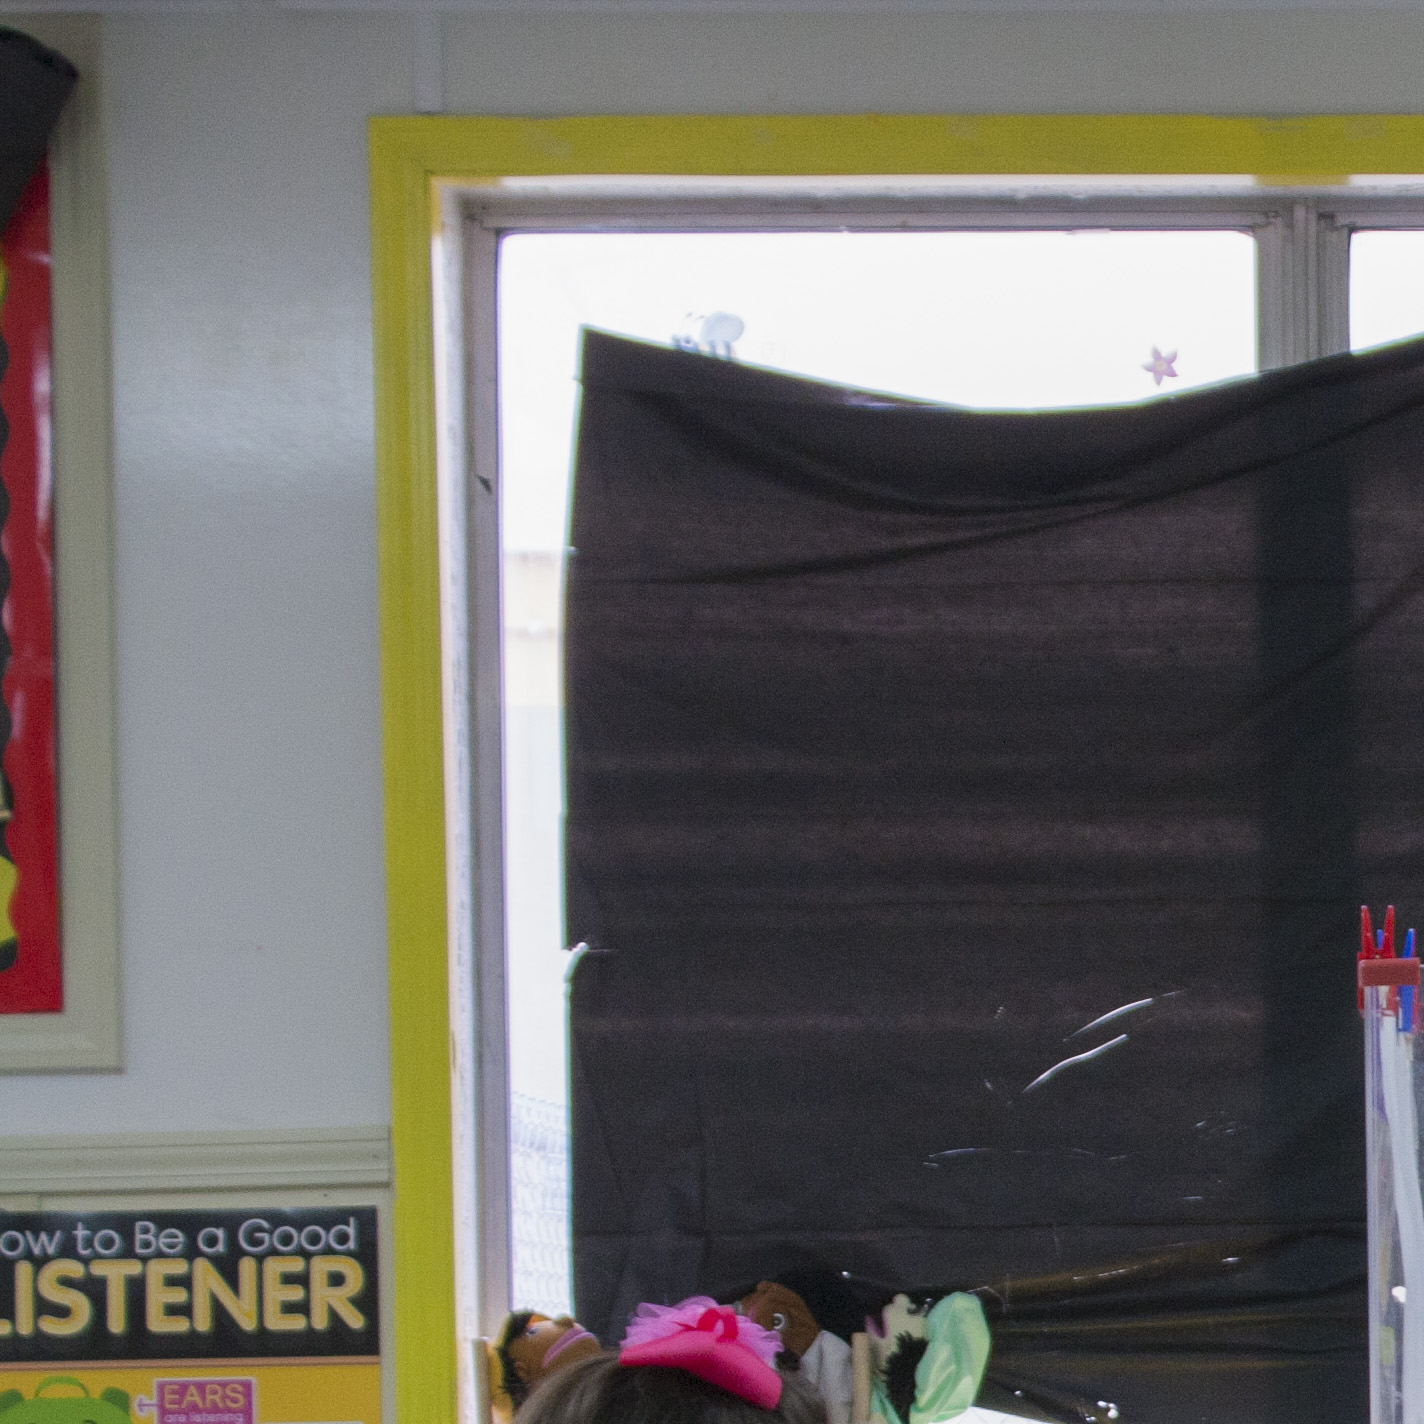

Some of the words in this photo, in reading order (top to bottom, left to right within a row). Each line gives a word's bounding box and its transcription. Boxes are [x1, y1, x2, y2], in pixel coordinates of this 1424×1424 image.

[0, 1230, 62, 1257] ow
[73, 1222, 121, 1255] to
[134, 1221, 186, 1254] Be
[197, 1226, 227, 1253] a
[238, 1218, 357, 1254] Good
[0, 1254, 366, 1337] ISTENER
[163, 1383, 246, 1410] EARS
[164, 1414, 187, 1423] are
[188, 1412, 245, 1424] listening
